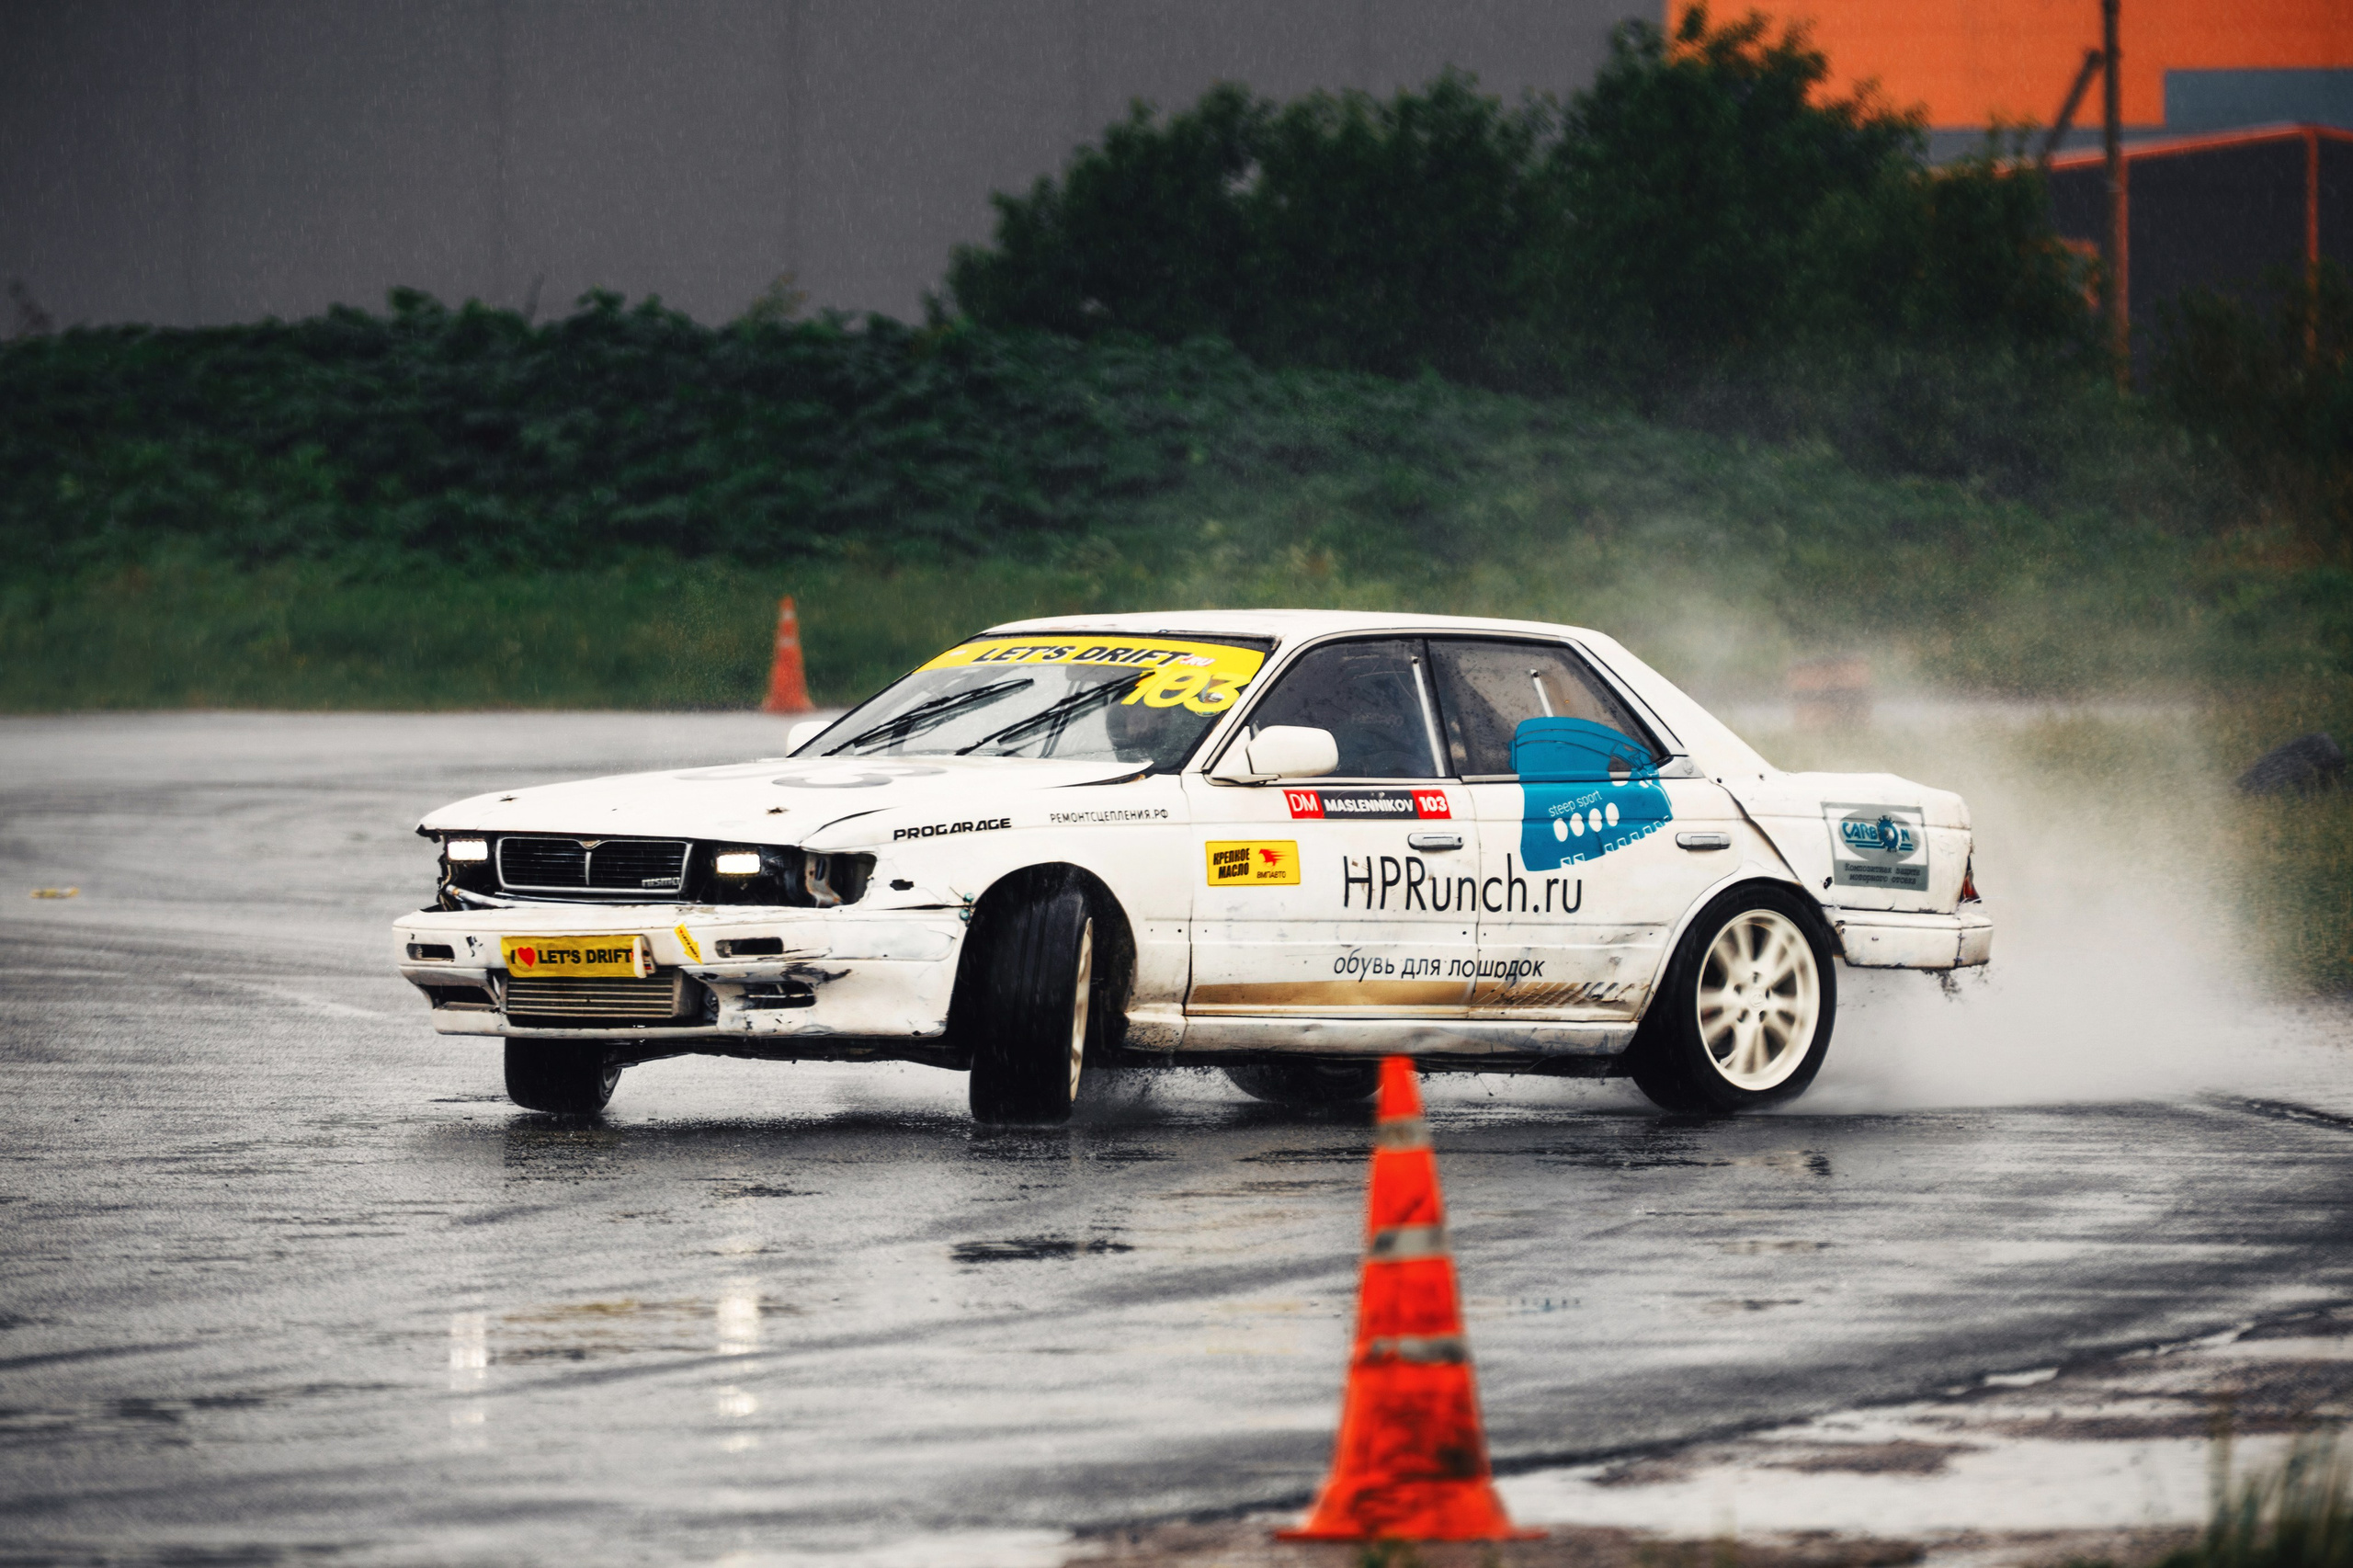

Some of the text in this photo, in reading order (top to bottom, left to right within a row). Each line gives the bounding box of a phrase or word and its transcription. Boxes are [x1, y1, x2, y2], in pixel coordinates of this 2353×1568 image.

[972, 645, 1076, 664] LET'S
[1120, 667, 1255, 712] 103
[1289, 793, 1448, 812] DM MASLENNIKOV 103
[1548, 790, 1603, 817] steep sport
[1050, 808, 1169, 824] РЕМОНТСЦЕПЛЕНИЯ.РФ
[892, 817, 1012, 841] PROGARAGE
[1841, 815, 1911, 853] CARBON
[1213, 847, 1250, 866] КРЕПКОЕ
[1218, 862, 1250, 880] МАСЛО
[1343, 852, 1583, 914] HPRunch.ru
[510, 948, 632, 964] I LET'S DRIFT
[1333, 947, 1395, 983] обувь
[1401, 958, 1441, 979] для
